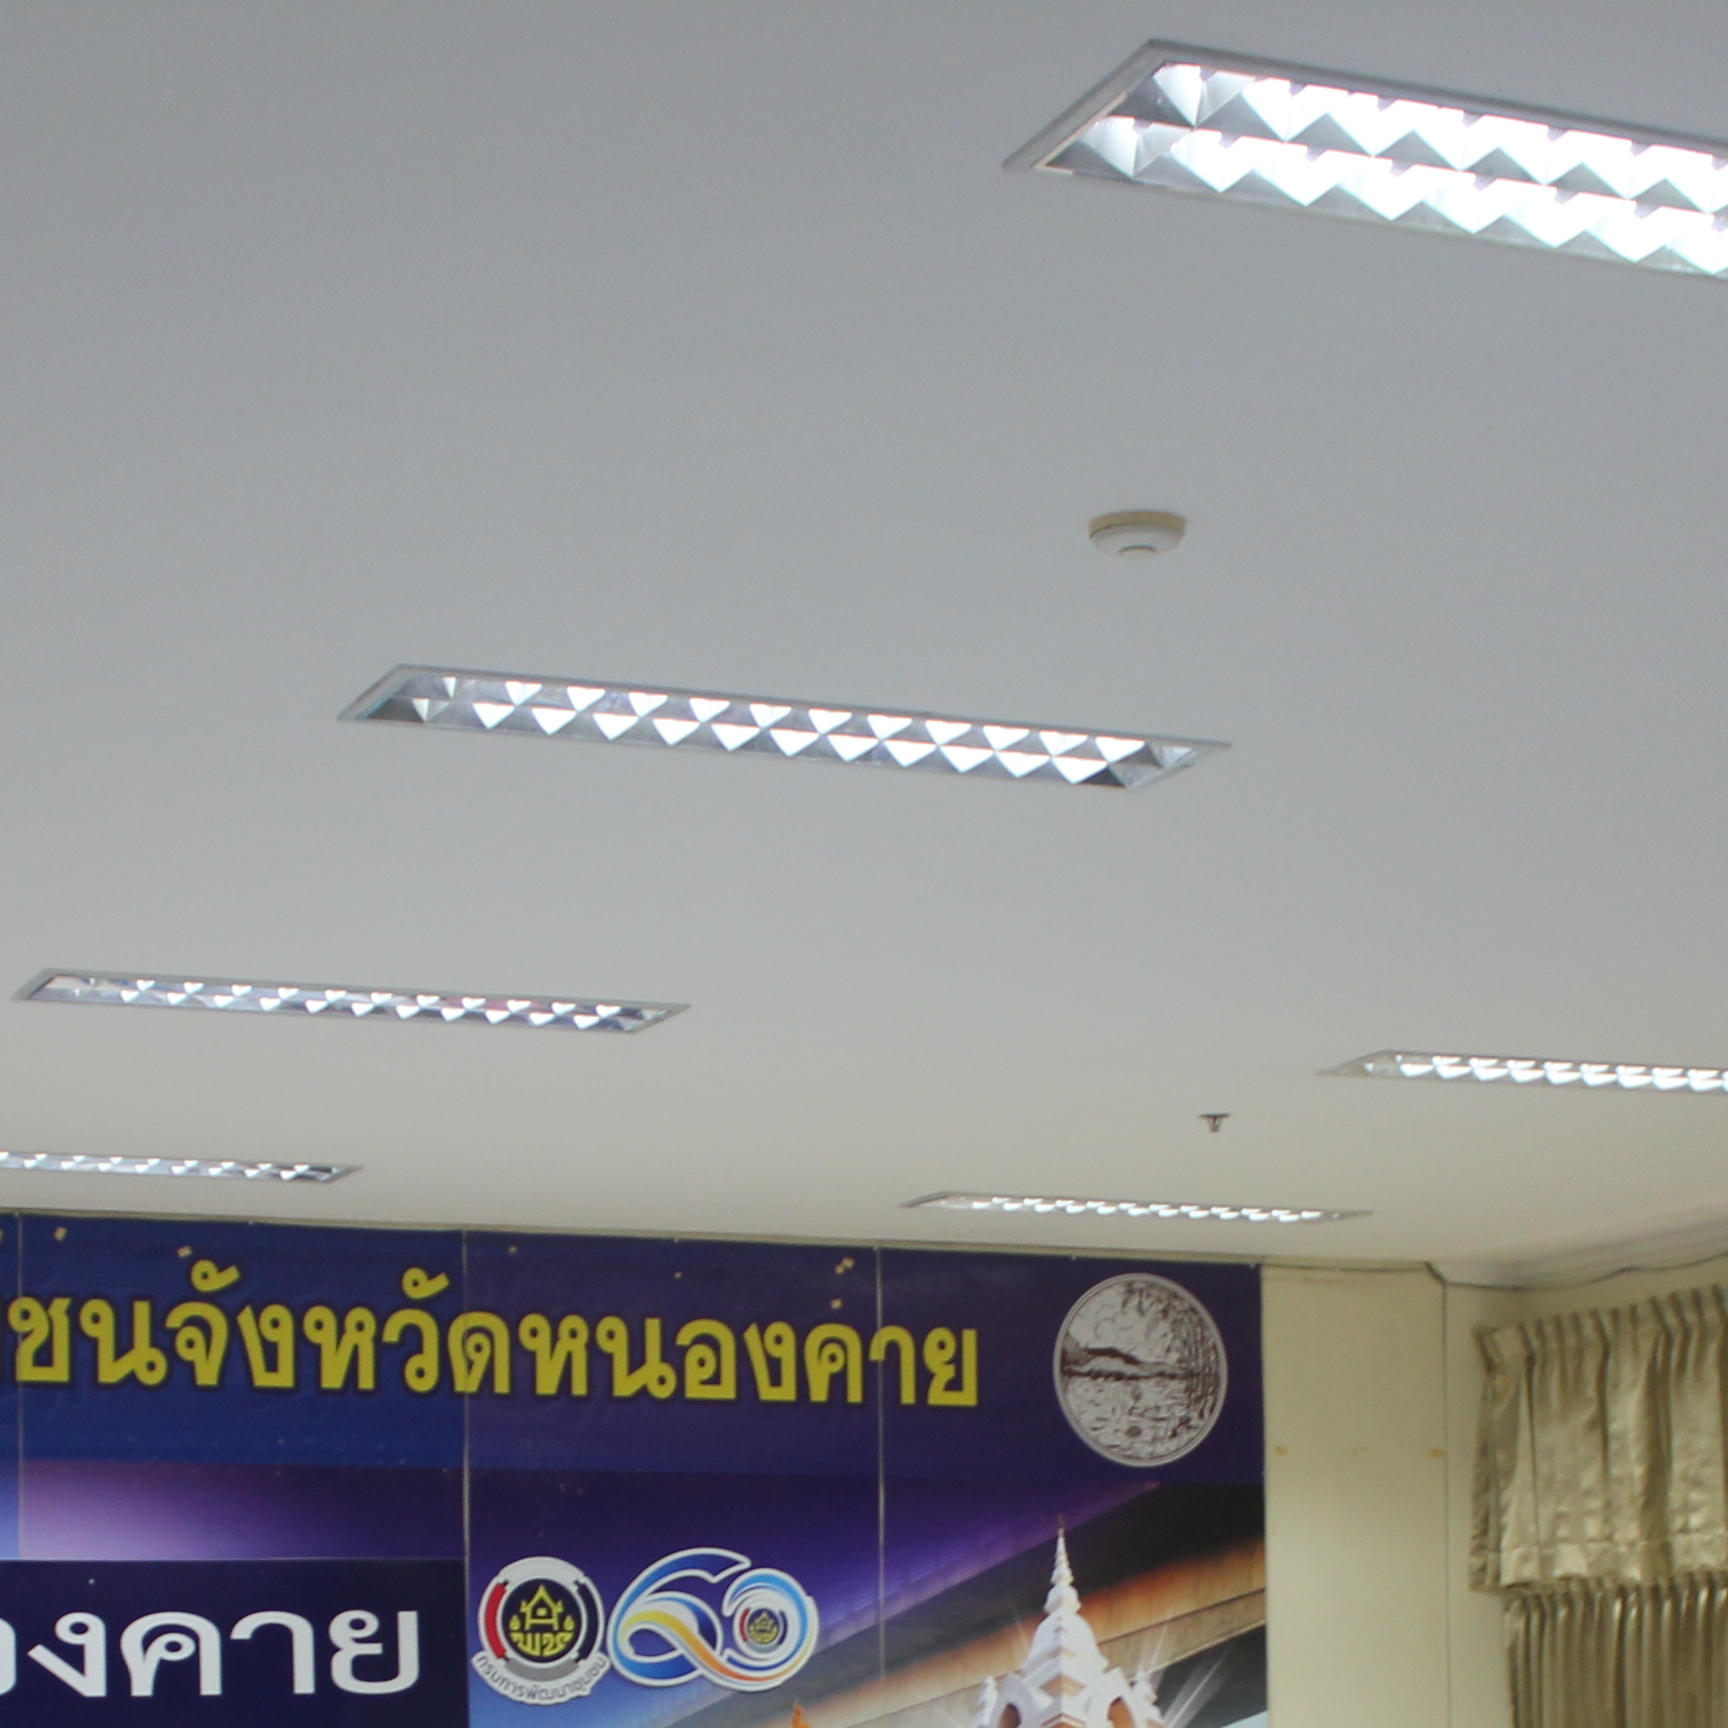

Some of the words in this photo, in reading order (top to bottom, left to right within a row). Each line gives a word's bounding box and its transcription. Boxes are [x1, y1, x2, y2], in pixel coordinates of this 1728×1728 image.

[475, 1655, 607, 1701] กรมการพัฒนาชุมชน
